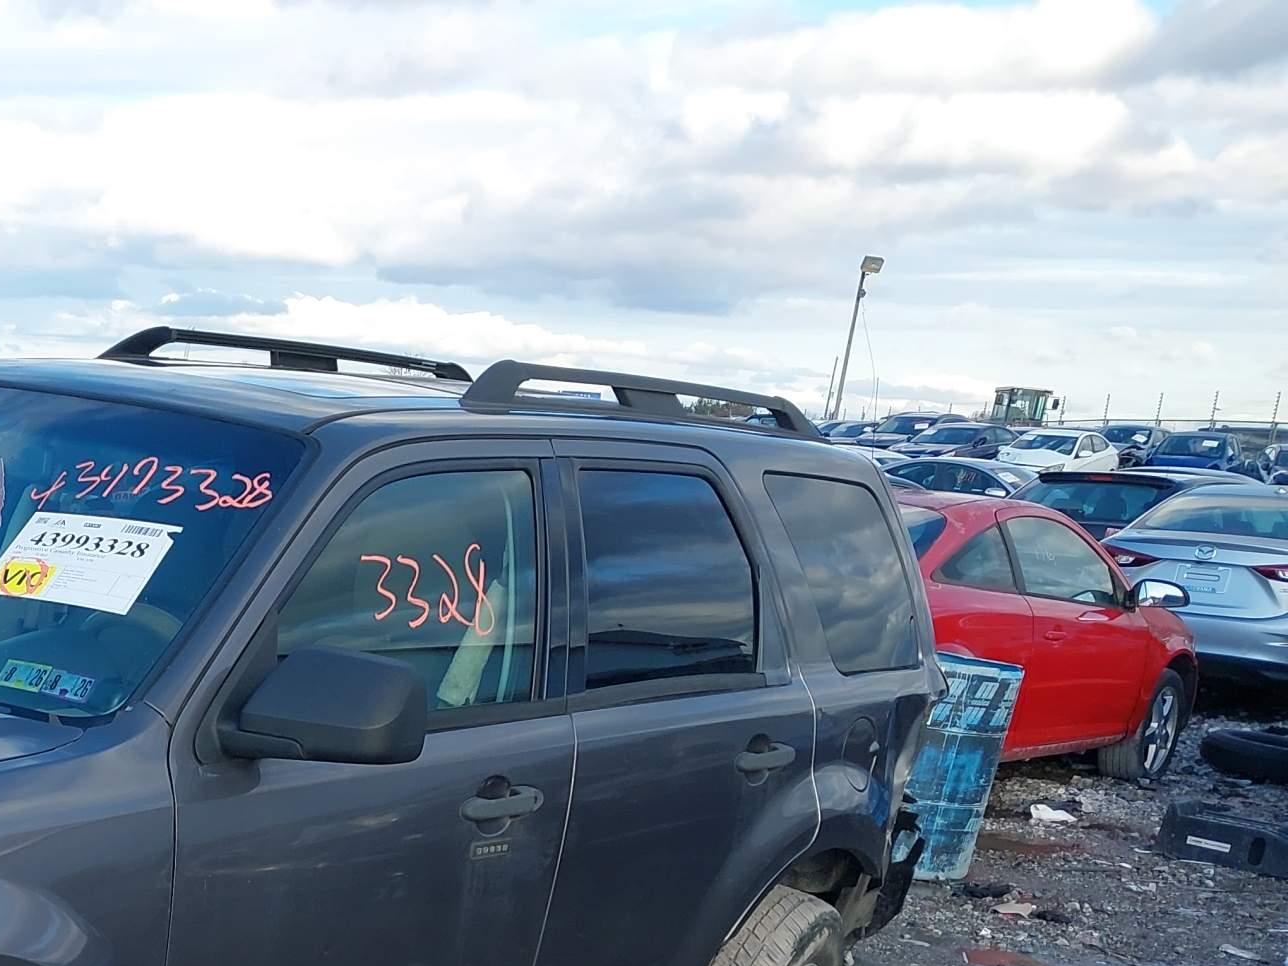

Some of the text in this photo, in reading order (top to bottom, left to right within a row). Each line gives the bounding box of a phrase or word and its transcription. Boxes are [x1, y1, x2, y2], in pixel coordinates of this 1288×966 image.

[30, 531, 150, 558] 43993328
[361, 544, 495, 636] 3328
[73, 679, 92, 698] 26
